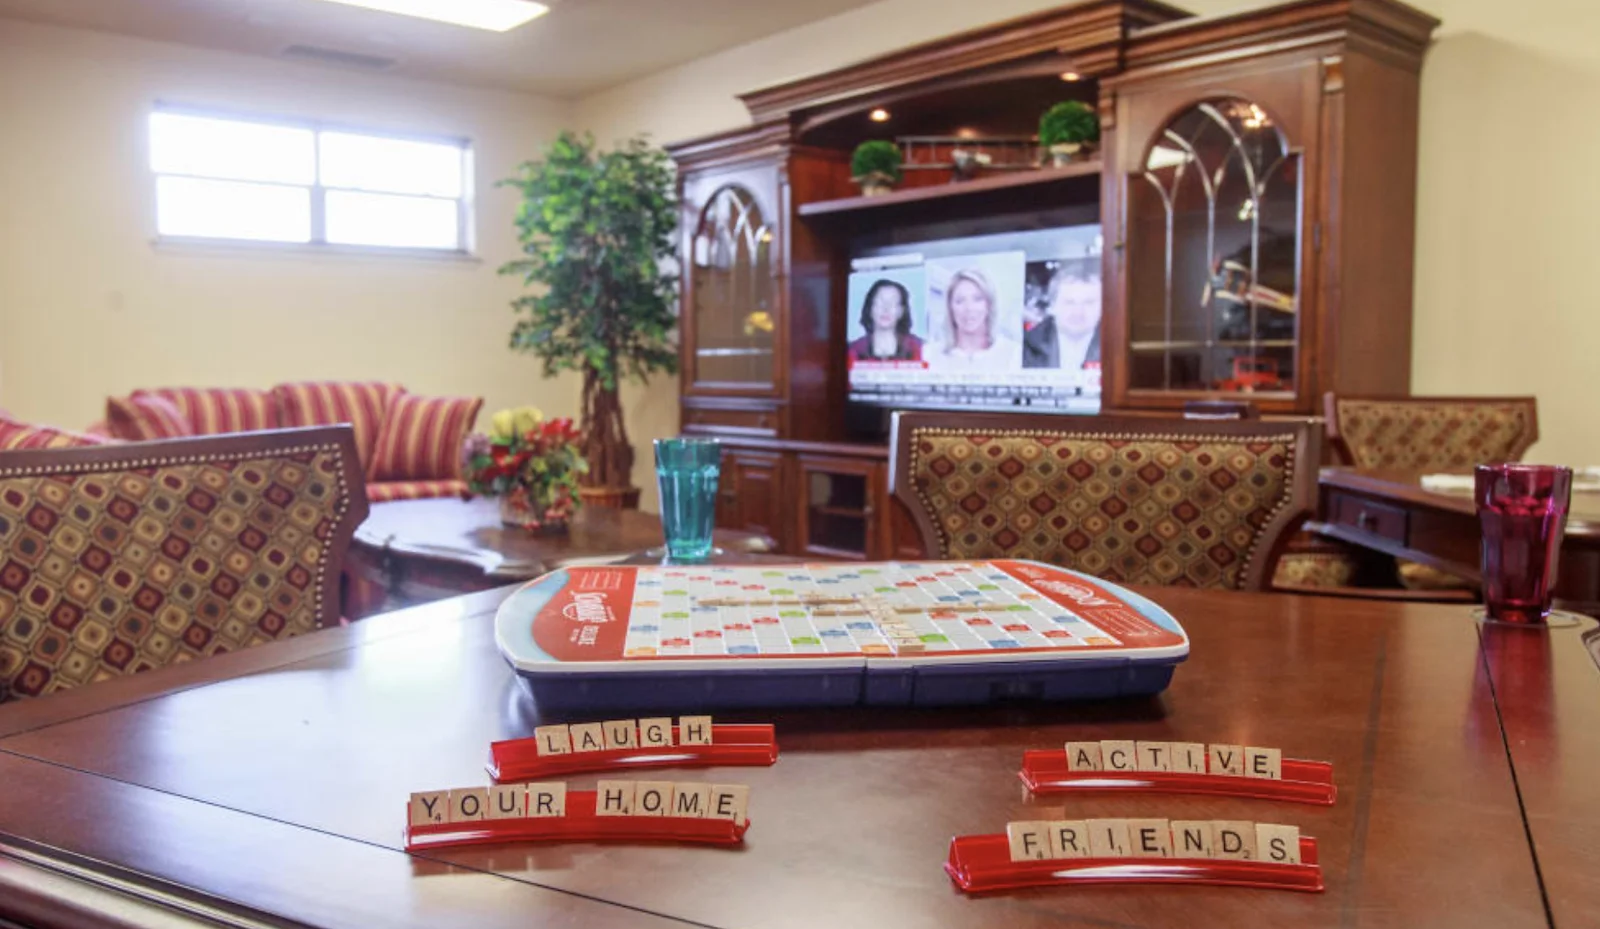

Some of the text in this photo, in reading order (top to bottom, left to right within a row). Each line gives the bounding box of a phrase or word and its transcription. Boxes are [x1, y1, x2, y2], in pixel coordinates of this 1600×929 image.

[546, 724, 708, 753] LAUGH
[1076, 748, 1272, 775] ACTIVE
[422, 789, 736, 821] YOUR HOME
[1023, 828, 1290, 862] FRIENDS
